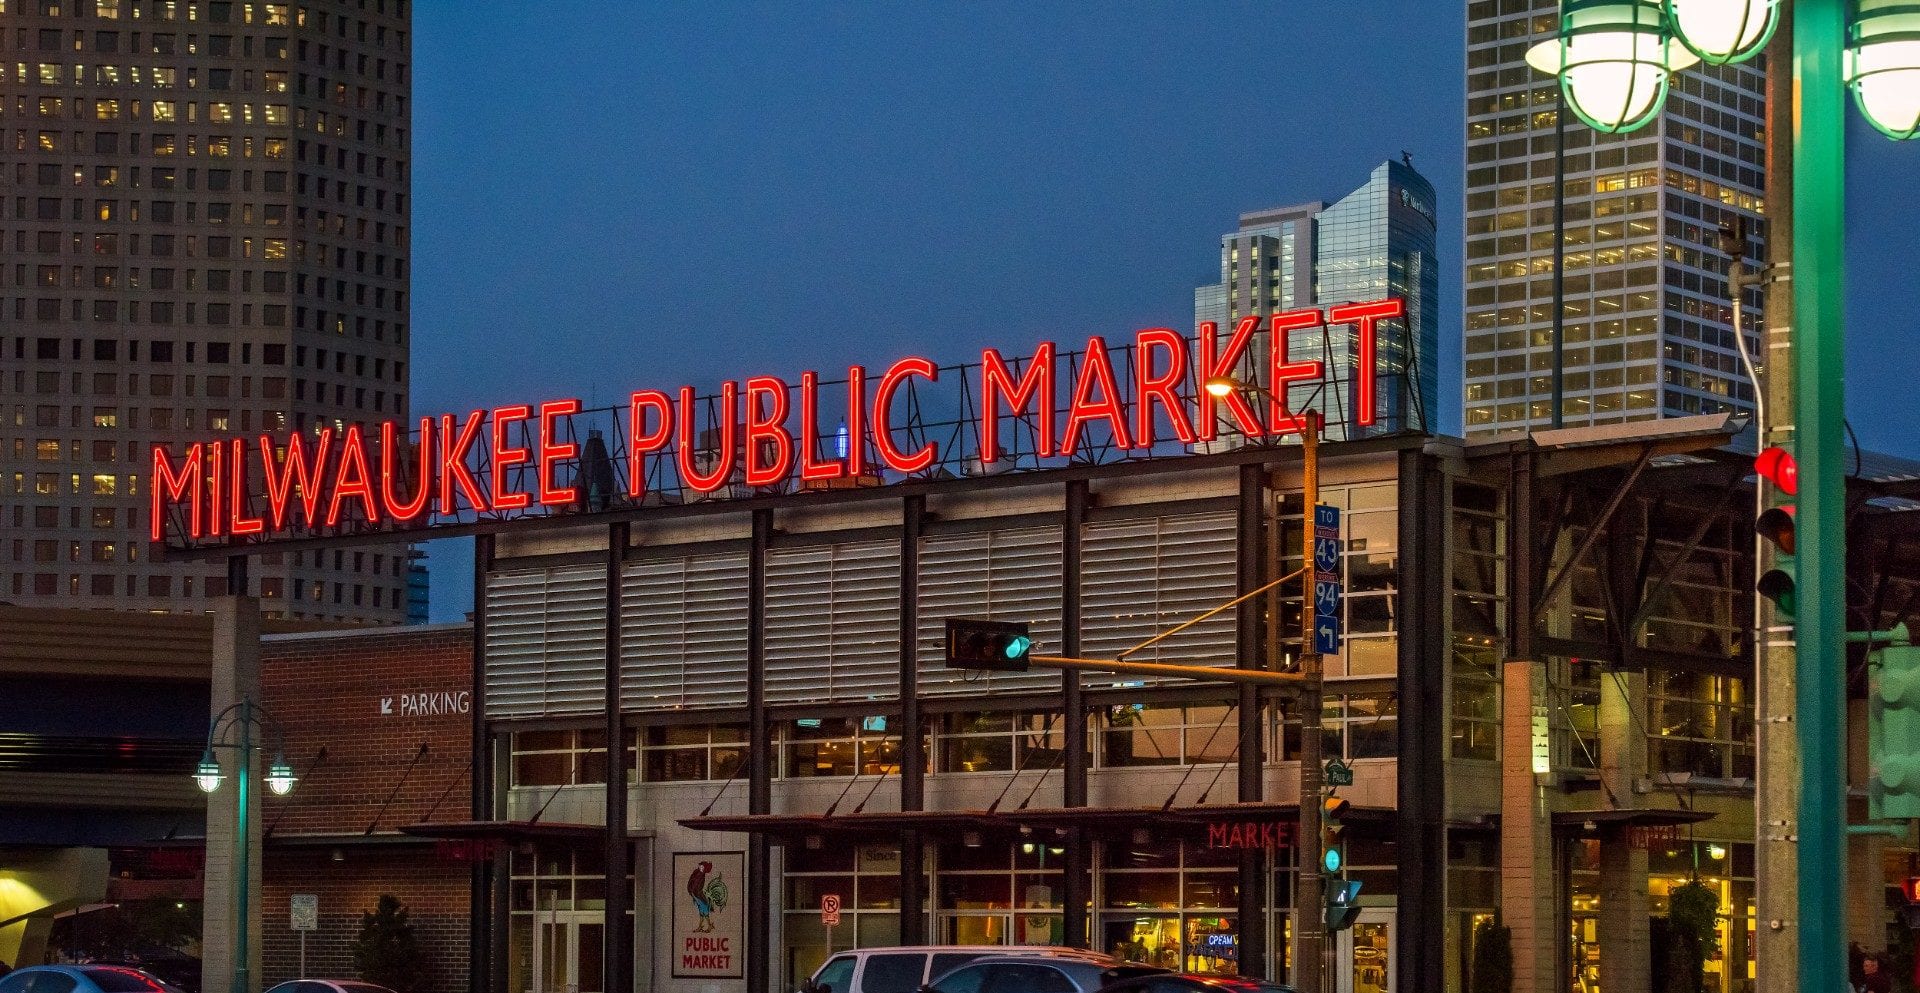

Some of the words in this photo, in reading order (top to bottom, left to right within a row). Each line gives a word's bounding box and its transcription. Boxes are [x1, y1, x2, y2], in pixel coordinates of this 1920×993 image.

[151, 399, 582, 542] MILWAUKEE
[629, 355, 939, 498] PUBLIC
[981, 297, 1406, 464] MARKET
[1320, 510, 1333, 523] TO
[1316, 538, 1337, 563] 43
[1316, 582, 1336, 607] 94
[401, 691, 469, 716] PARKING
[685, 937, 729, 951] PUBLIC
[682, 954, 731, 969] MARKET
